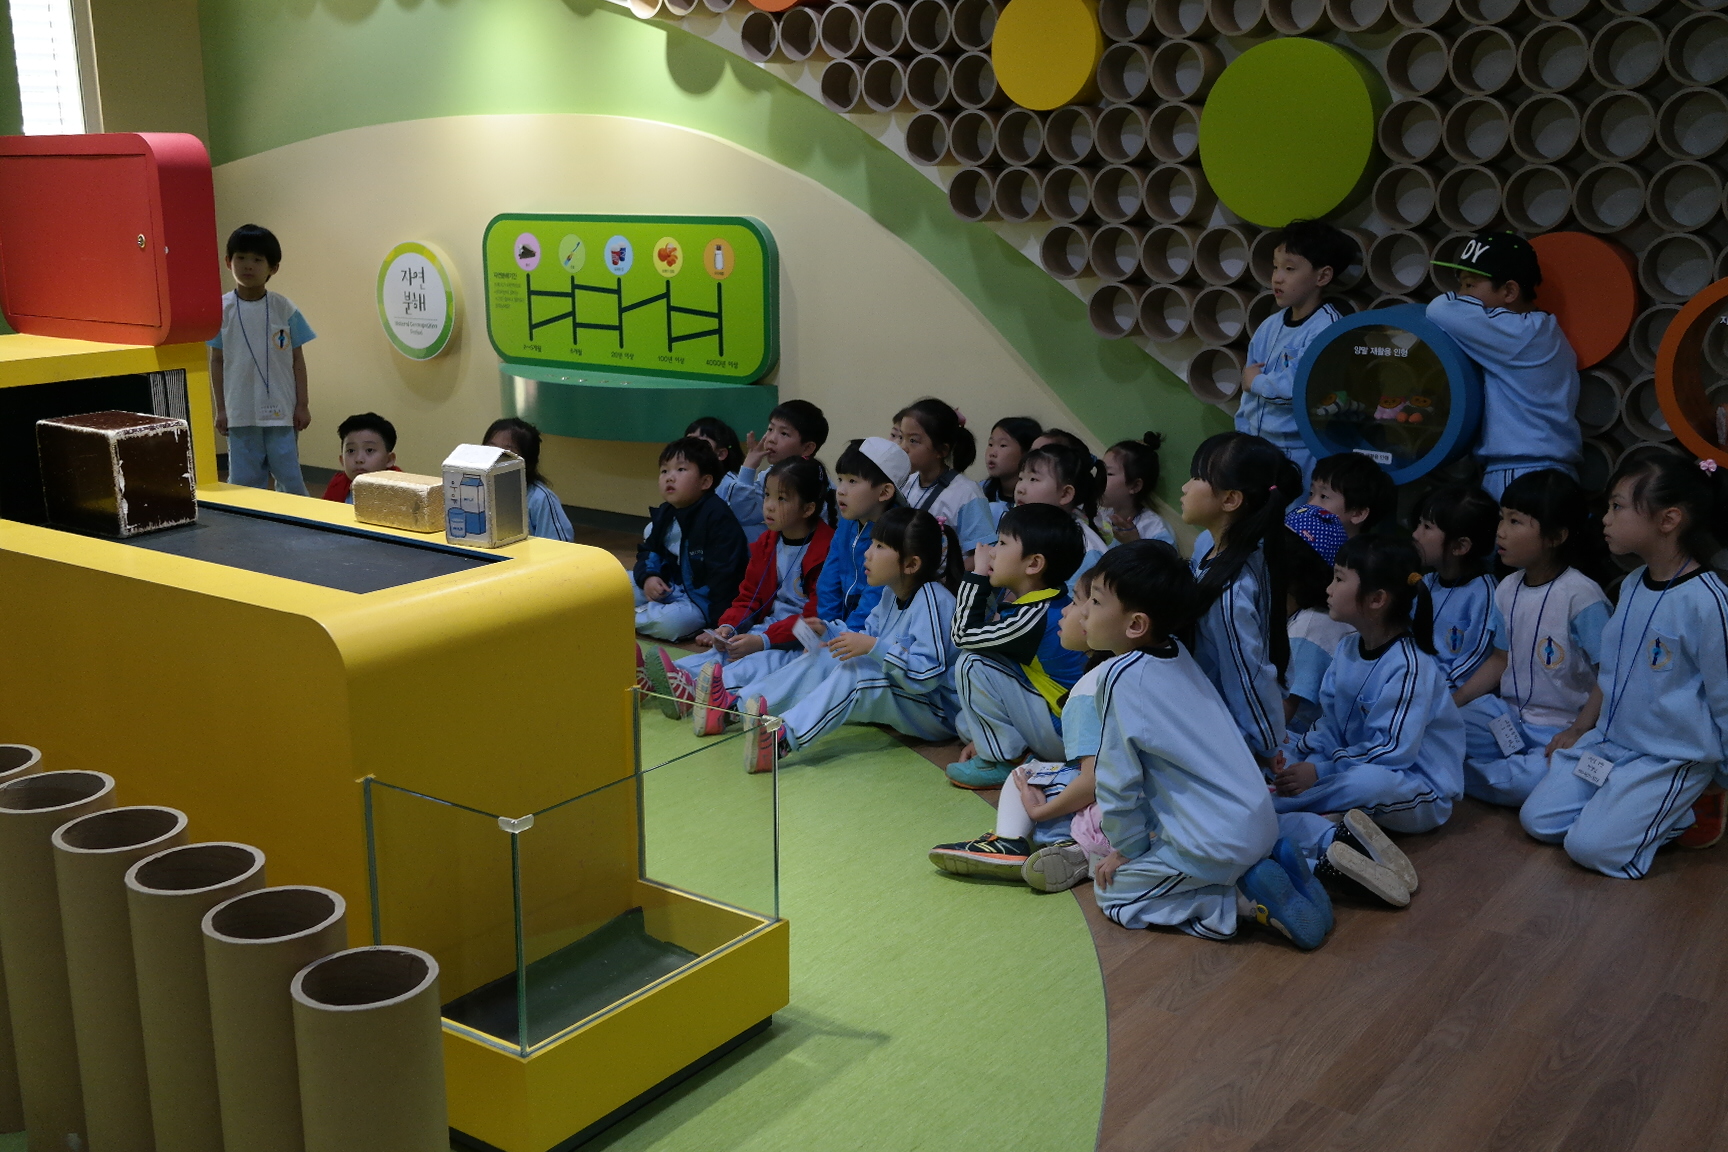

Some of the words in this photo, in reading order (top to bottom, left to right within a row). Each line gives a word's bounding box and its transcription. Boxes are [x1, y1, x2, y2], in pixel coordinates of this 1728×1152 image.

[401, 266, 425, 290] 자연
[402, 291, 426, 315] 분해
[1354, 345, 1368, 355] 양말
[1370, 347, 1391, 356] 재활용
[1393, 348, 1408, 357] 인형
